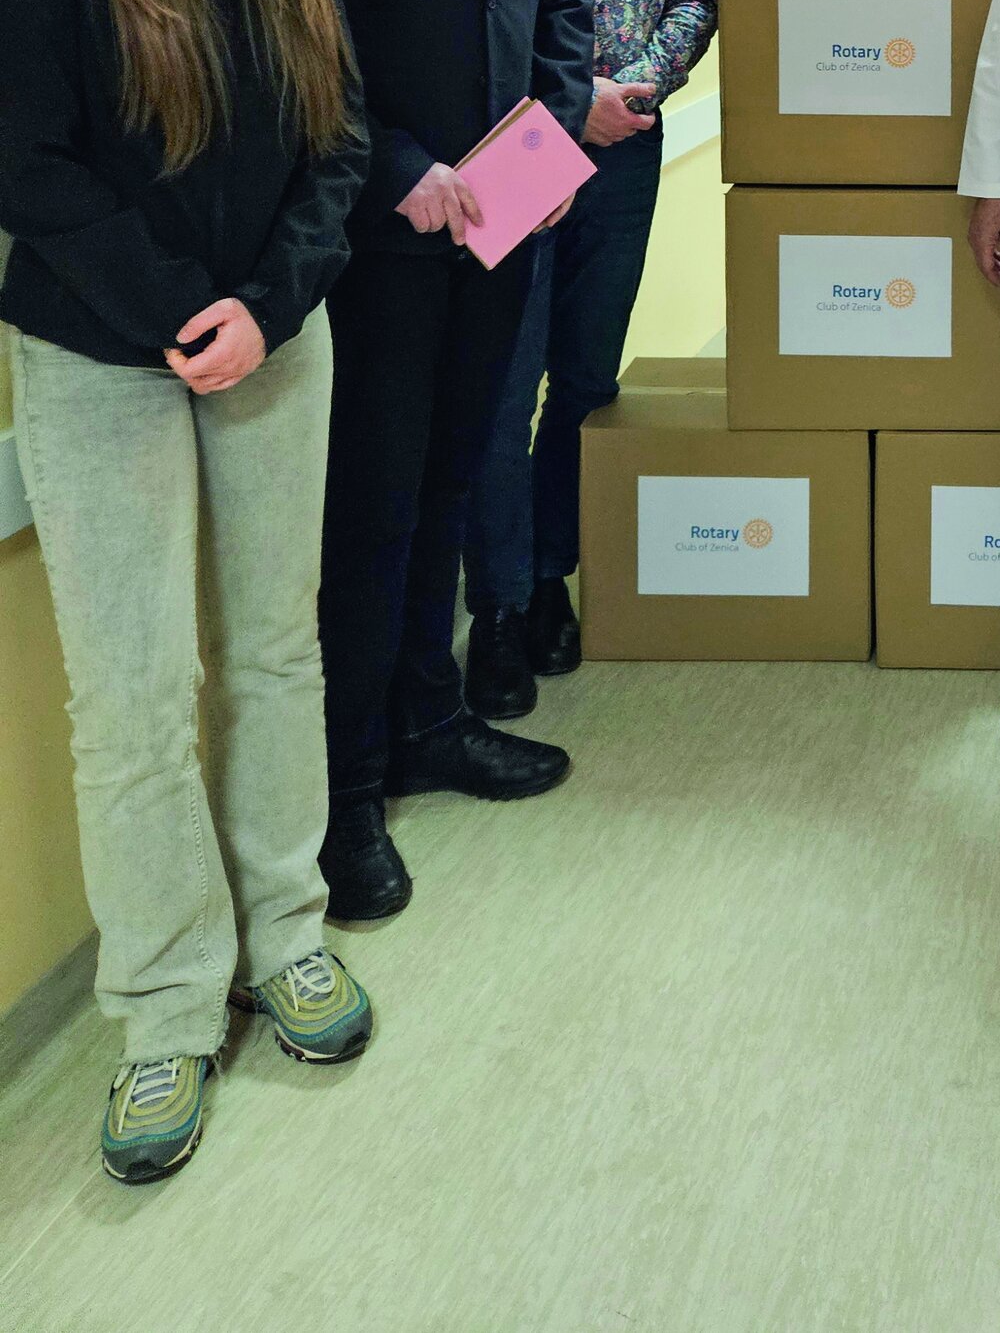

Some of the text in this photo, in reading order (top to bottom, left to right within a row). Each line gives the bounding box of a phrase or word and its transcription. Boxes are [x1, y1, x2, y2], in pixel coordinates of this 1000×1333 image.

[832, 44, 882, 61] Rotary
[815, 62, 881, 72] Club of Zenica
[832, 284, 882, 301] Rotary
[816, 302, 882, 313] Club of Zenica
[690, 525, 740, 542] Rotary
[674, 542, 740, 553] Club of Zenica
[968, 552, 990, 562] Club
[991, 552, 1000, 562] of
